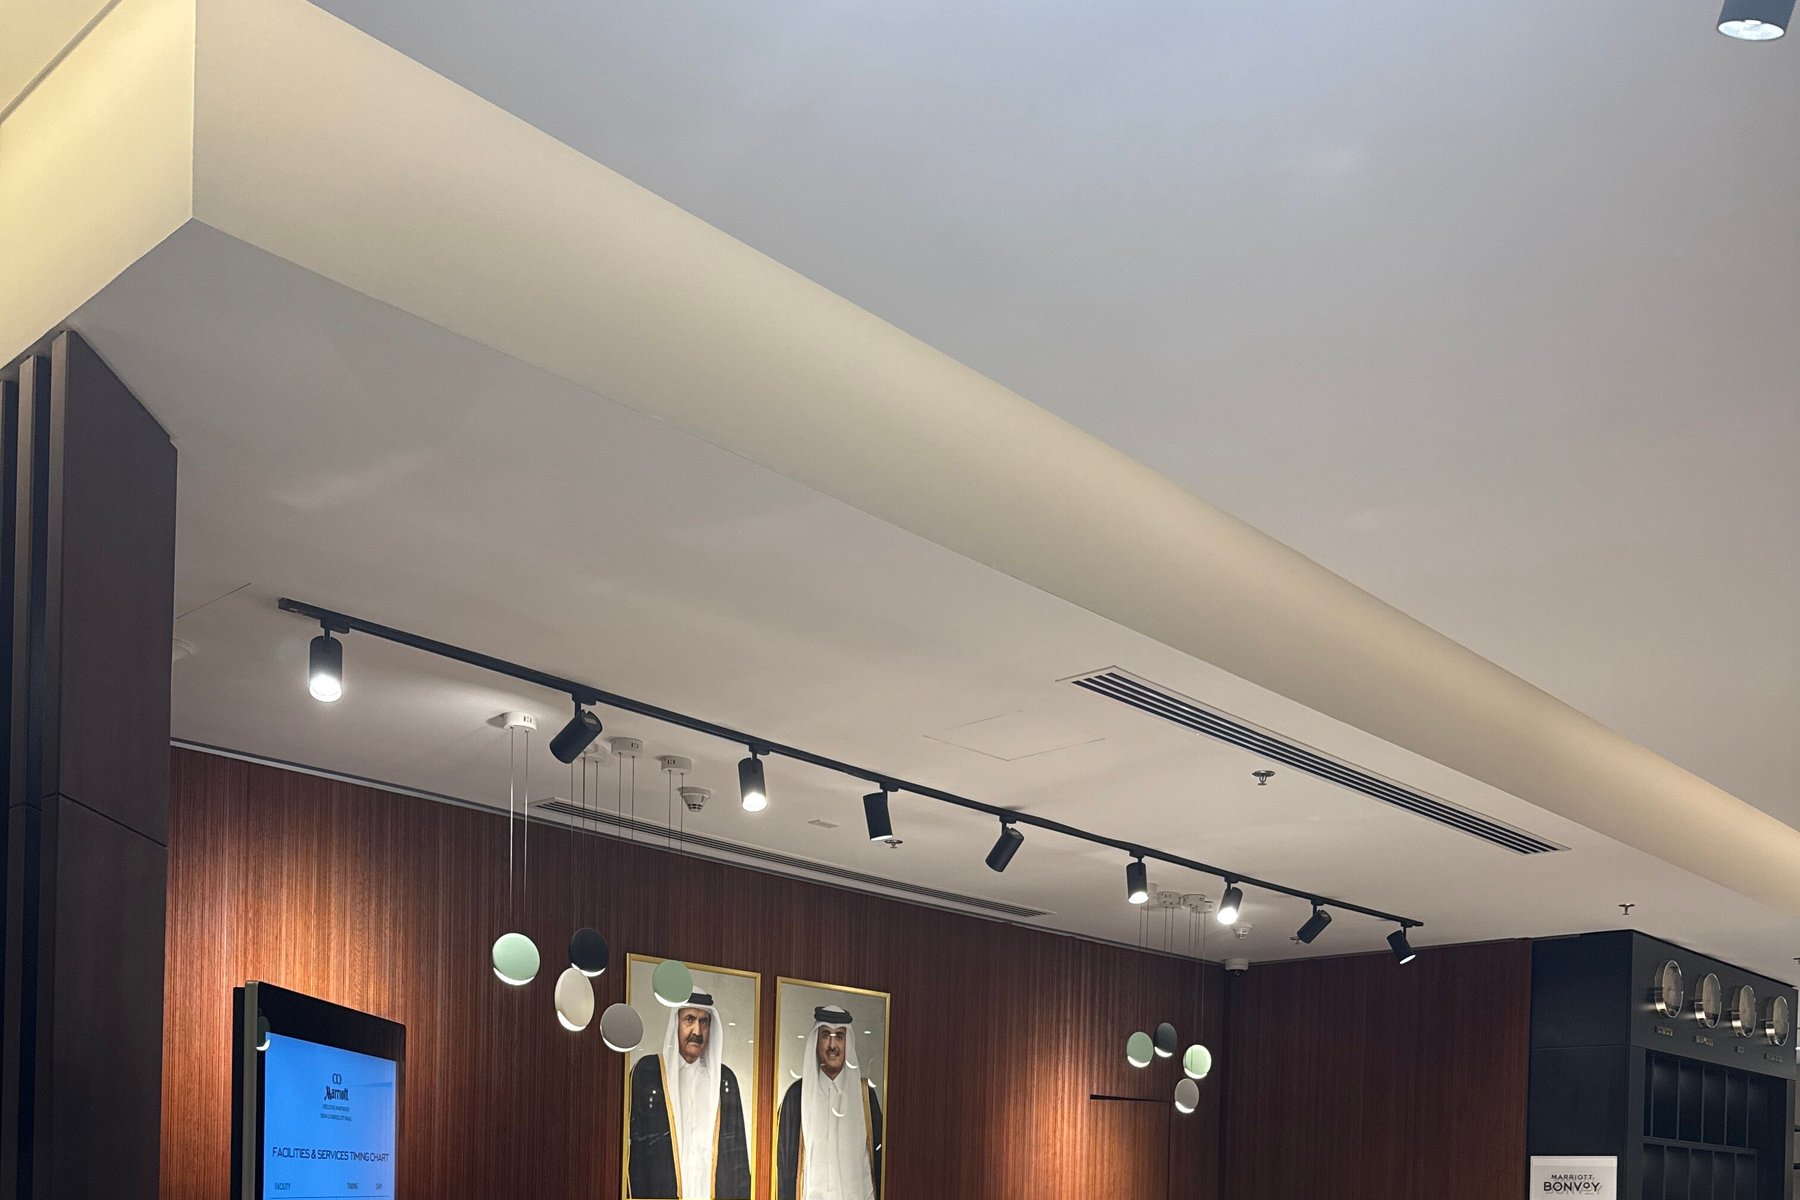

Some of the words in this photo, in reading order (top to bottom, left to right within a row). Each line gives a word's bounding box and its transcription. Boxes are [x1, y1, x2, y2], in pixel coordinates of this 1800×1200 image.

[324, 1085, 349, 1101] Marriott
[272, 1147, 310, 1159] FACILITIES
[311, 1149, 316, 1159] &
[317, 1150, 349, 1161] SERVICES
[349, 1152, 370, 1162] TIMING
[370, 1152, 390, 1163] CHART
[1543, 1181, 1601, 1192] BONVOY
